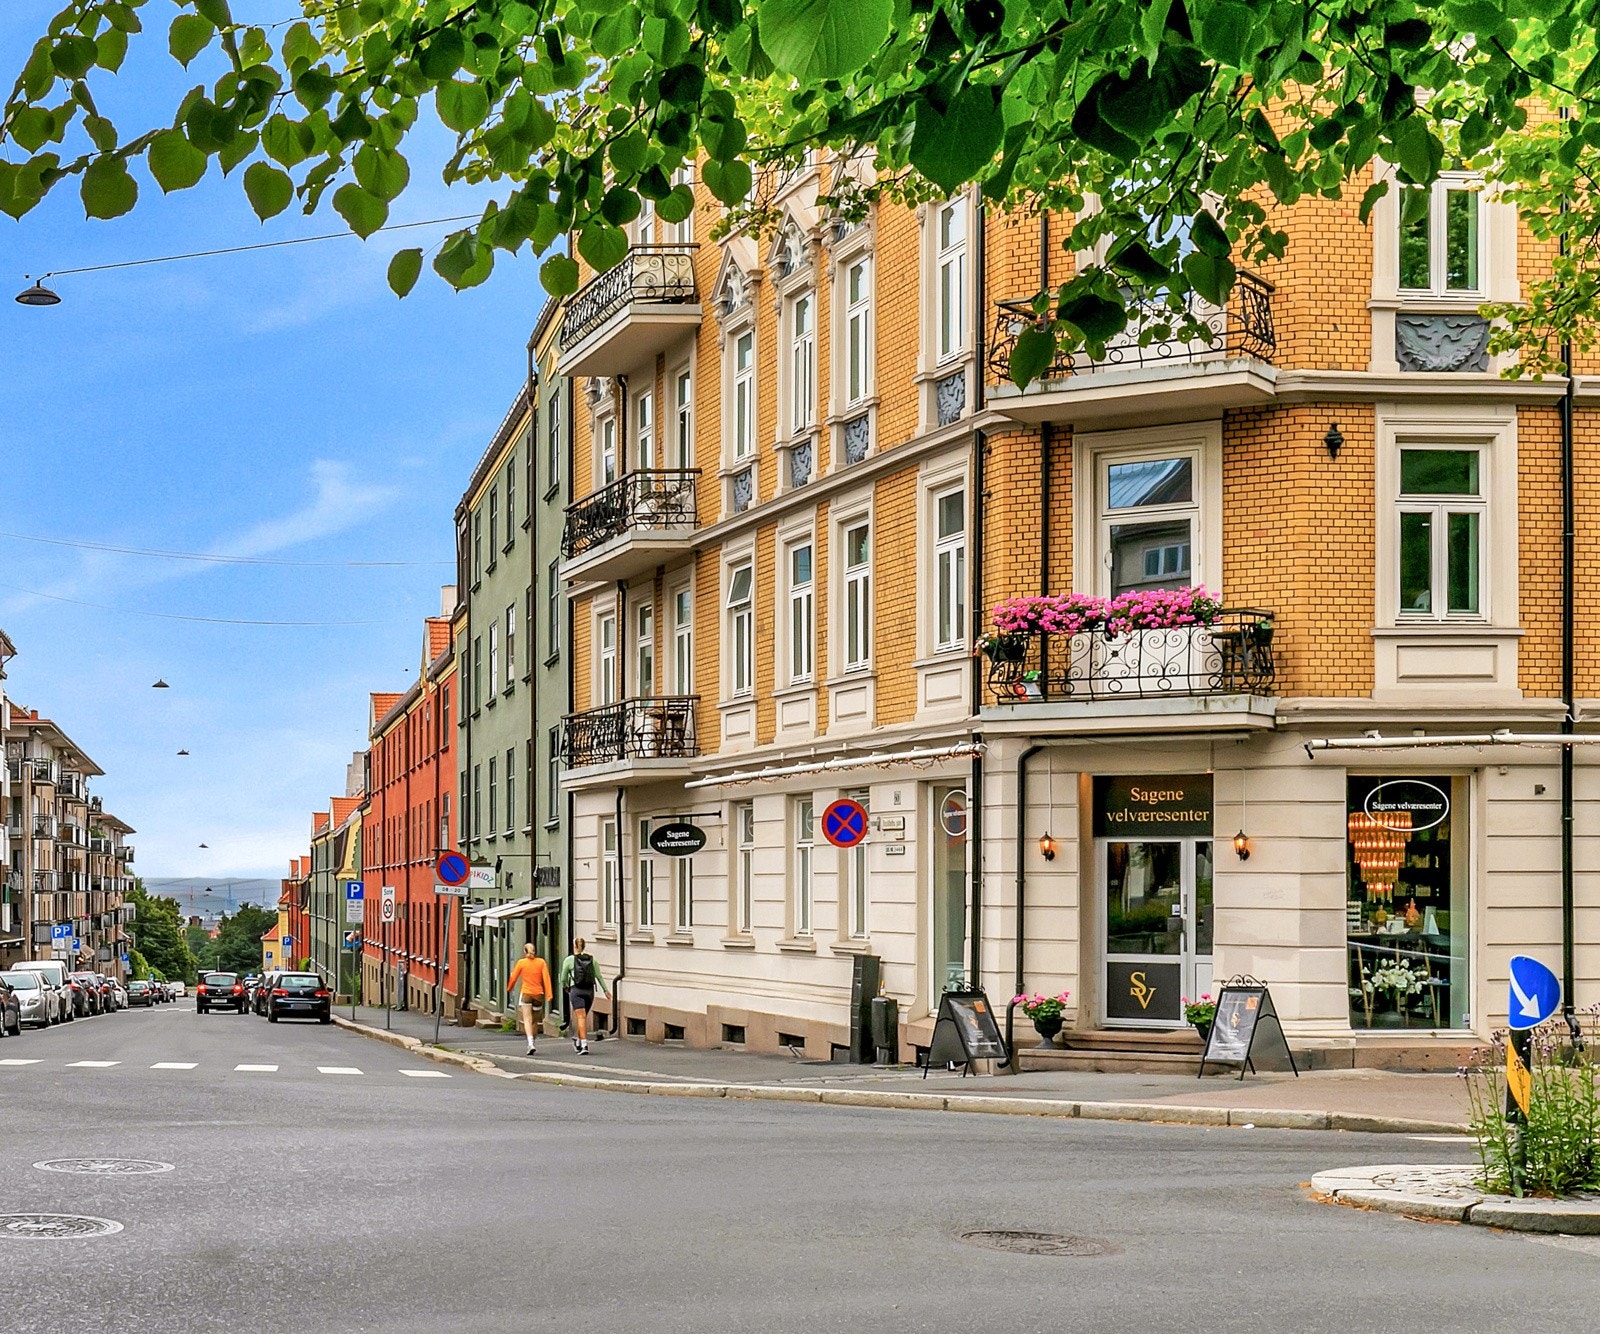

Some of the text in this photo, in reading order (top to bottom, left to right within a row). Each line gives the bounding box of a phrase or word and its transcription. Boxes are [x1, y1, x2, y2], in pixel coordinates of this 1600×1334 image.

[1130, 787, 1184, 805] Sagene
[1372, 801, 1443, 811] Sagene velværesenter
[1106, 808, 1210, 822] velværesenter
[666, 830, 690, 840] Sagene
[657, 840, 701, 848] velværesenter
[350, 884, 360, 898] P
[54, 928, 61, 937] P
[64, 926, 70, 935] P
[1130, 971, 1157, 1009] SV
